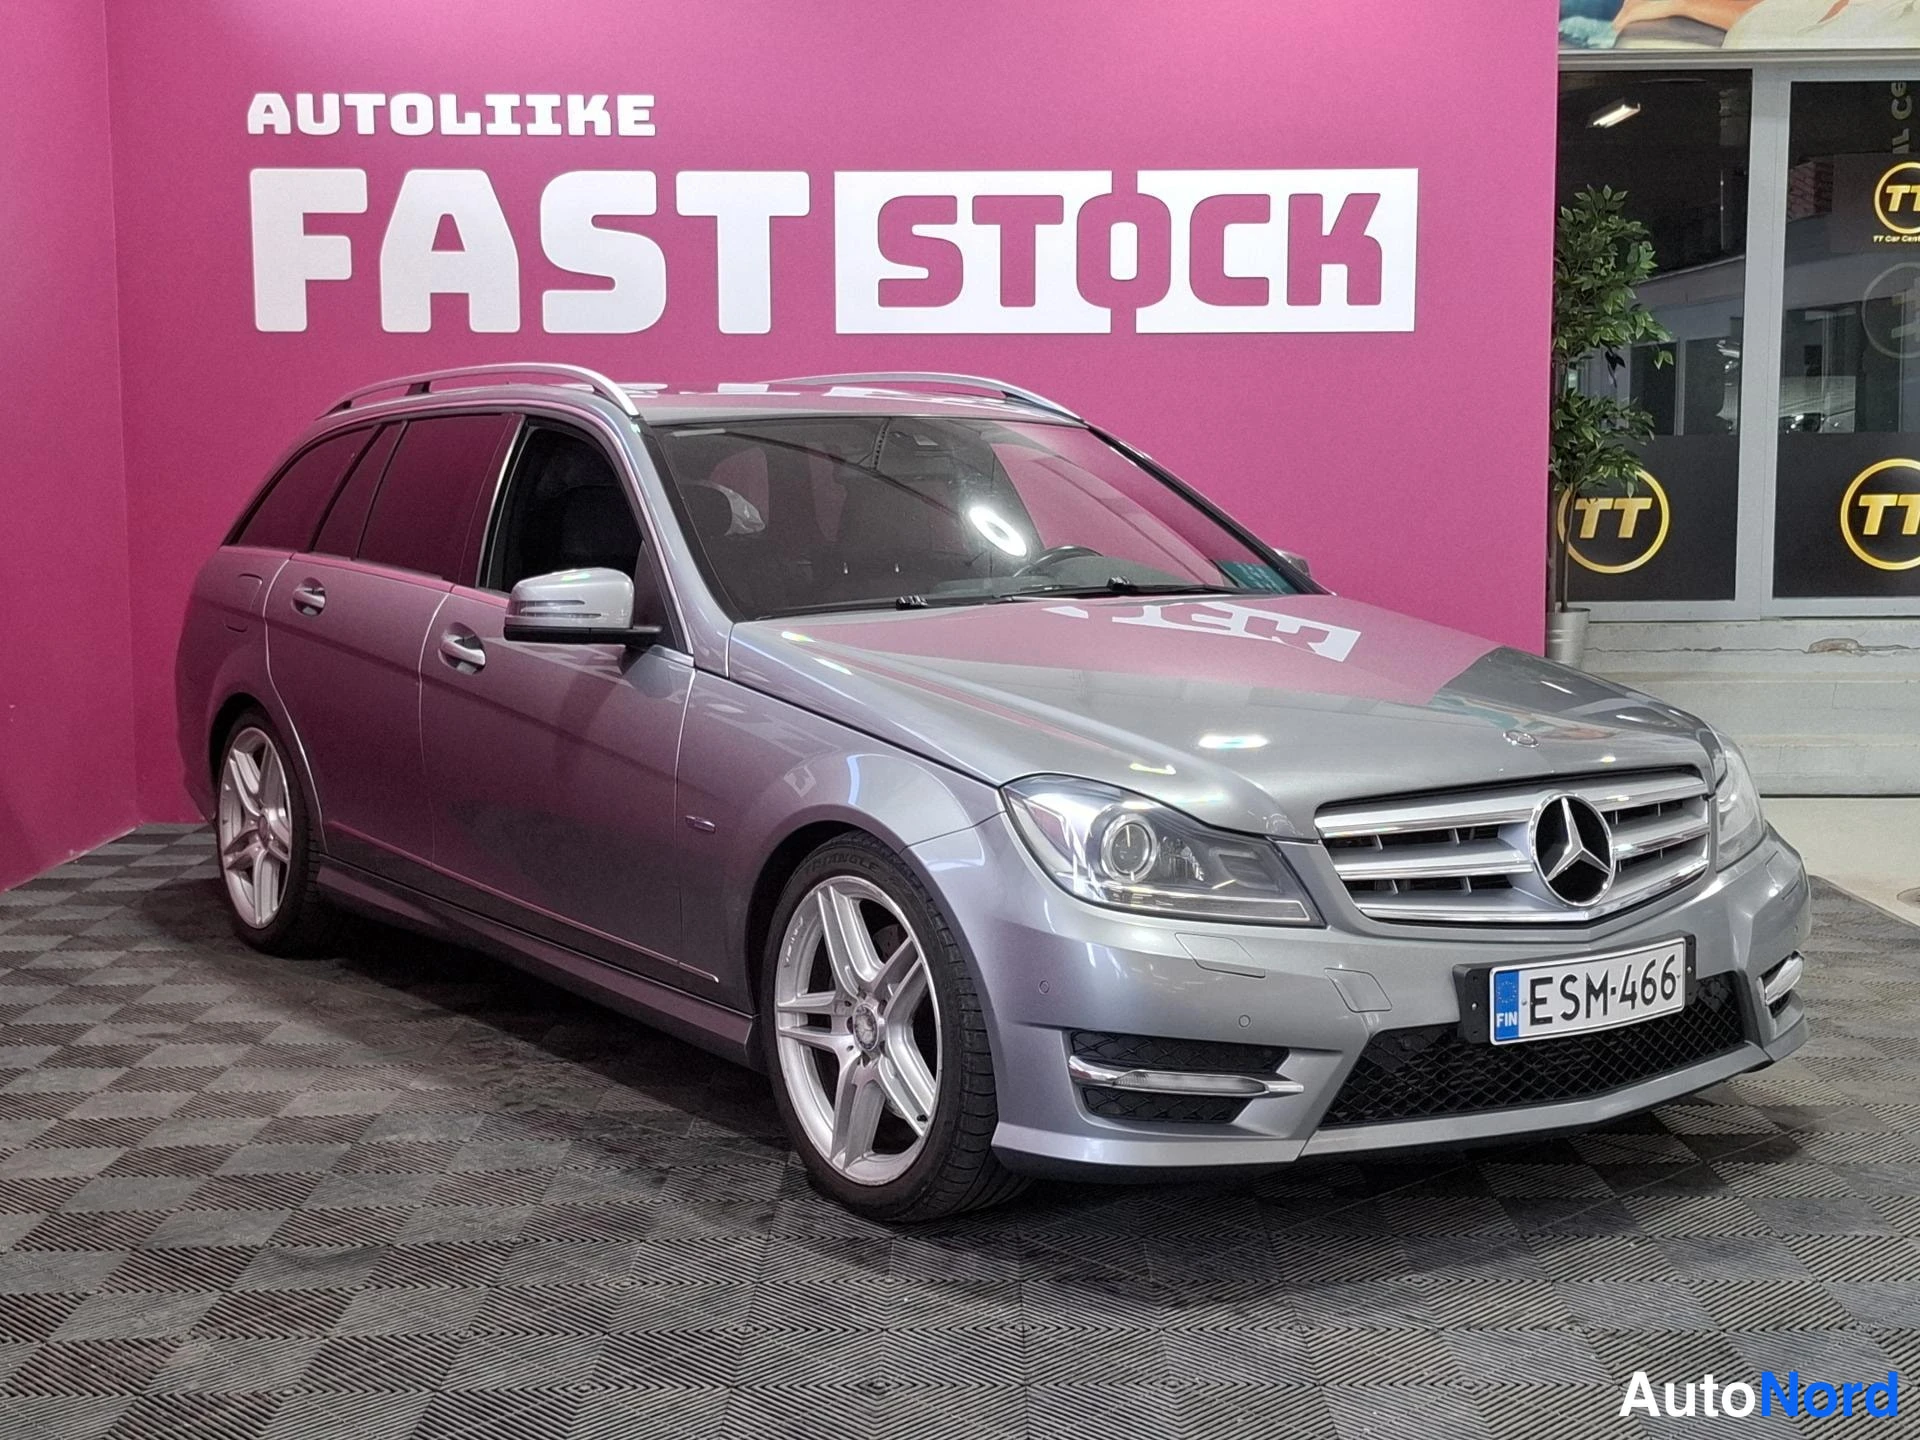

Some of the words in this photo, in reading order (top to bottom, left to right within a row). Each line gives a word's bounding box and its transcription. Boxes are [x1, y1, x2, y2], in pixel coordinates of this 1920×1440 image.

[247, 92, 656, 137] AUTOLIIKE
[249, 167, 811, 334] FAST
[877, 192, 1383, 308] STOCK
[1574, 497, 1653, 539] TT
[1529, 953, 1678, 1027] ESM-466
[1495, 1010, 1519, 1029] FIN
